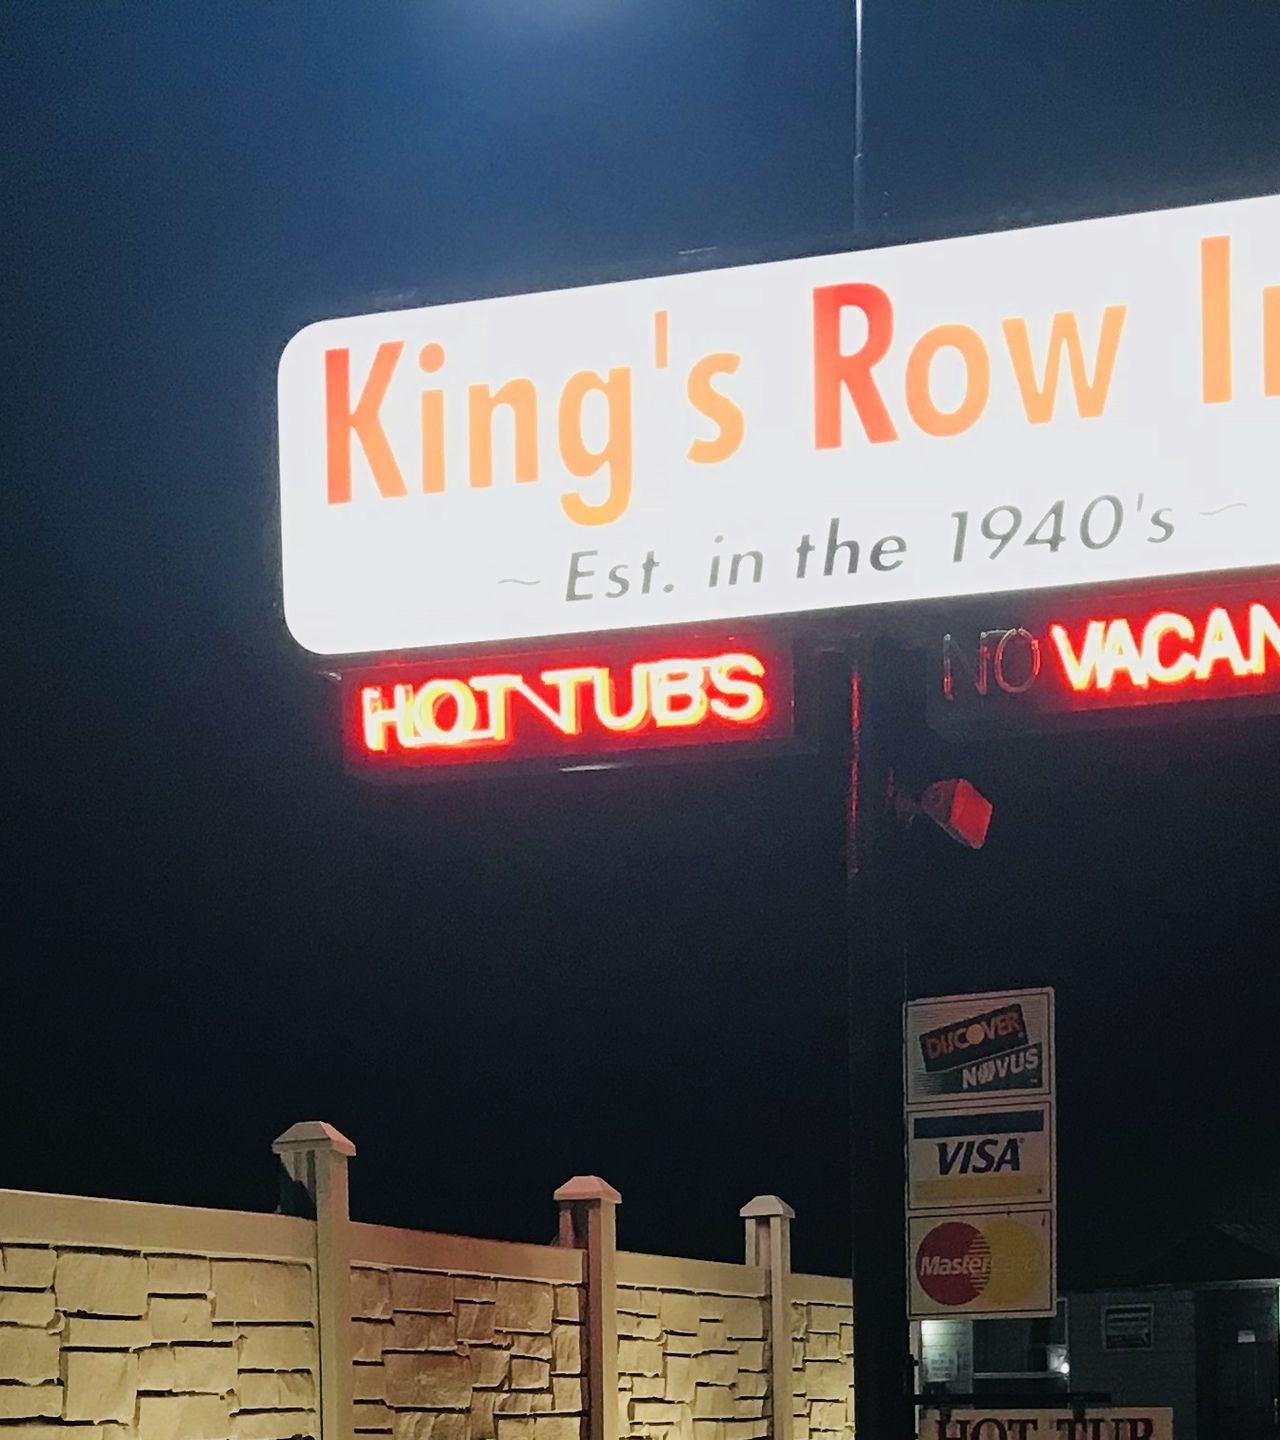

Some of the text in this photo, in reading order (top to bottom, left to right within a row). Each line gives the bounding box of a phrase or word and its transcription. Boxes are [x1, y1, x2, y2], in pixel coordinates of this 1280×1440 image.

[323, 310, 745, 527] King's
[812, 282, 1127, 450] Row
[564, 493, 1176, 602] Est. in the 1940's
[362, 653, 767, 751] HOT TUBS
[942, 627, 1041, 698] NO
[962, 1048, 1040, 1089] NOVUS
[936, 1138, 1021, 1175] VISA
